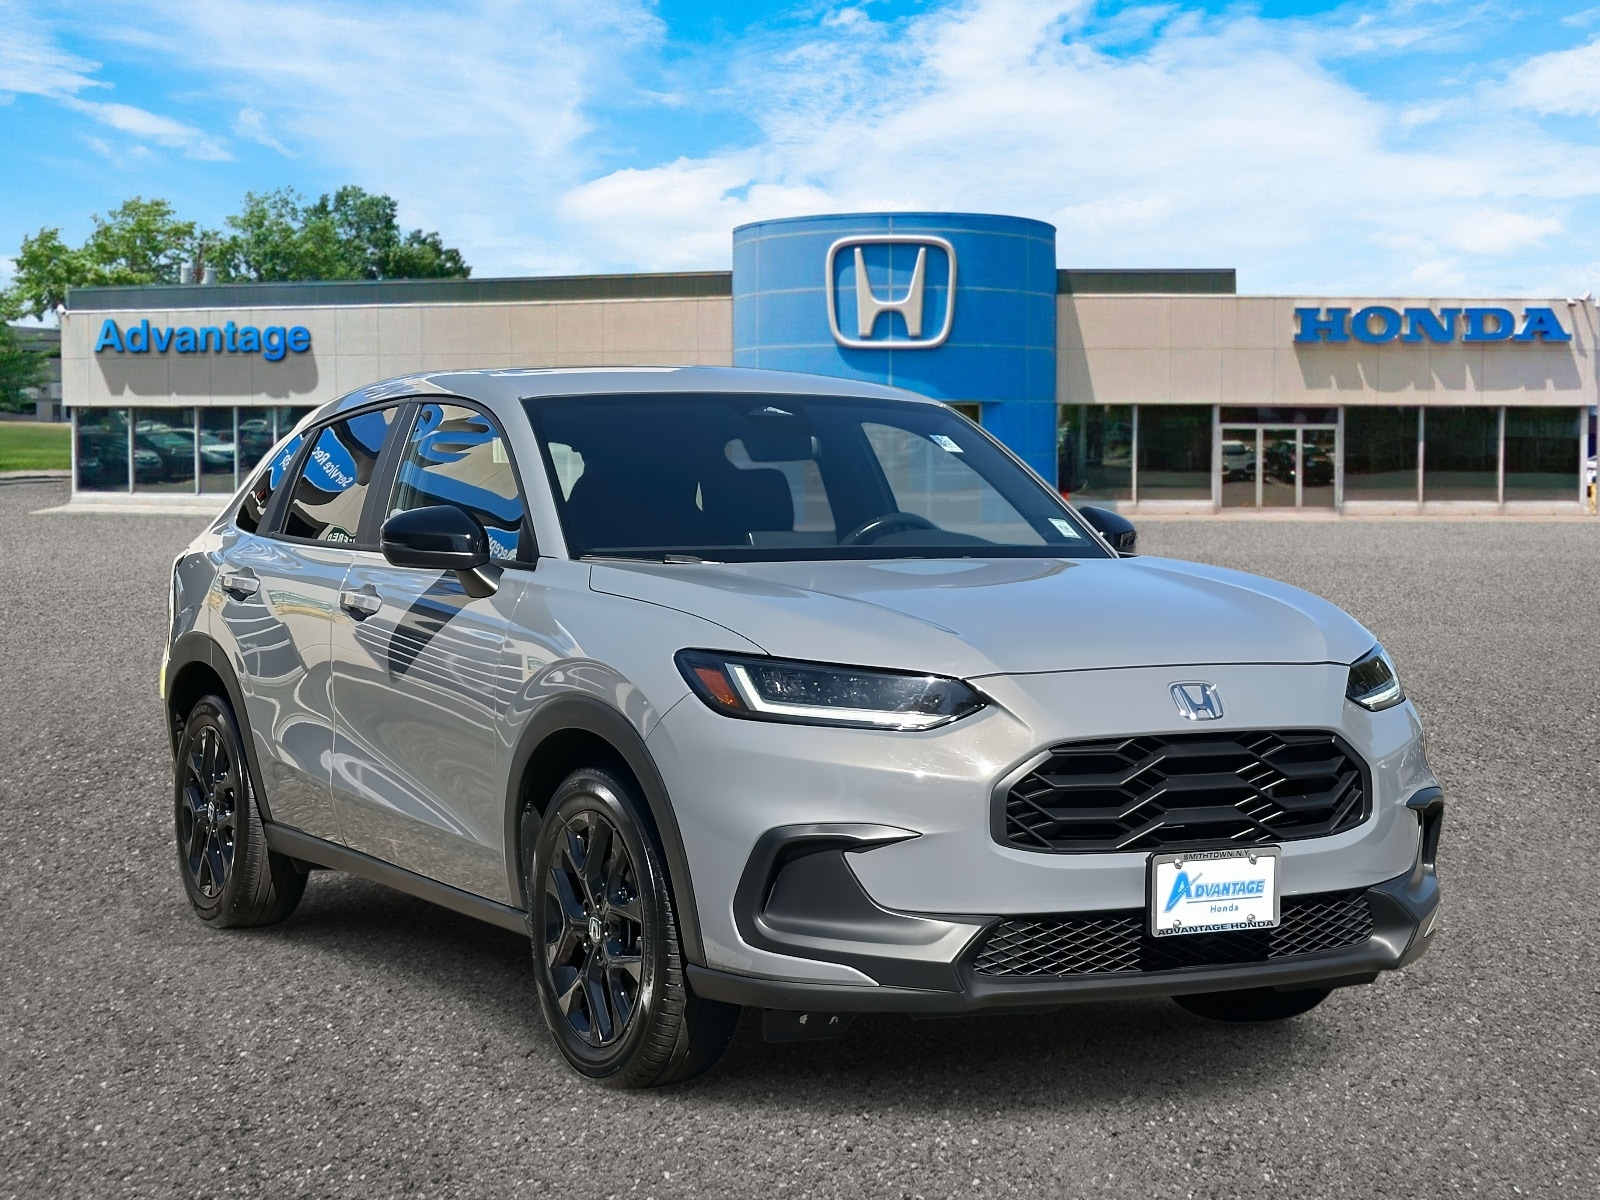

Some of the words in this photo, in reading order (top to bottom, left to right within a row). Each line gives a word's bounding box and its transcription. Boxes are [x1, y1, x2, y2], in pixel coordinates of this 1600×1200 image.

[94, 318, 312, 362] Advantage
[1294, 305, 1573, 344] HONDA
[1163, 871, 1266, 914] ADVANTAGE
[1210, 903, 1239, 914] Honda
[1157, 923, 1228, 937] ADVANTAGE
[1231, 920, 1275, 930] HONDA
